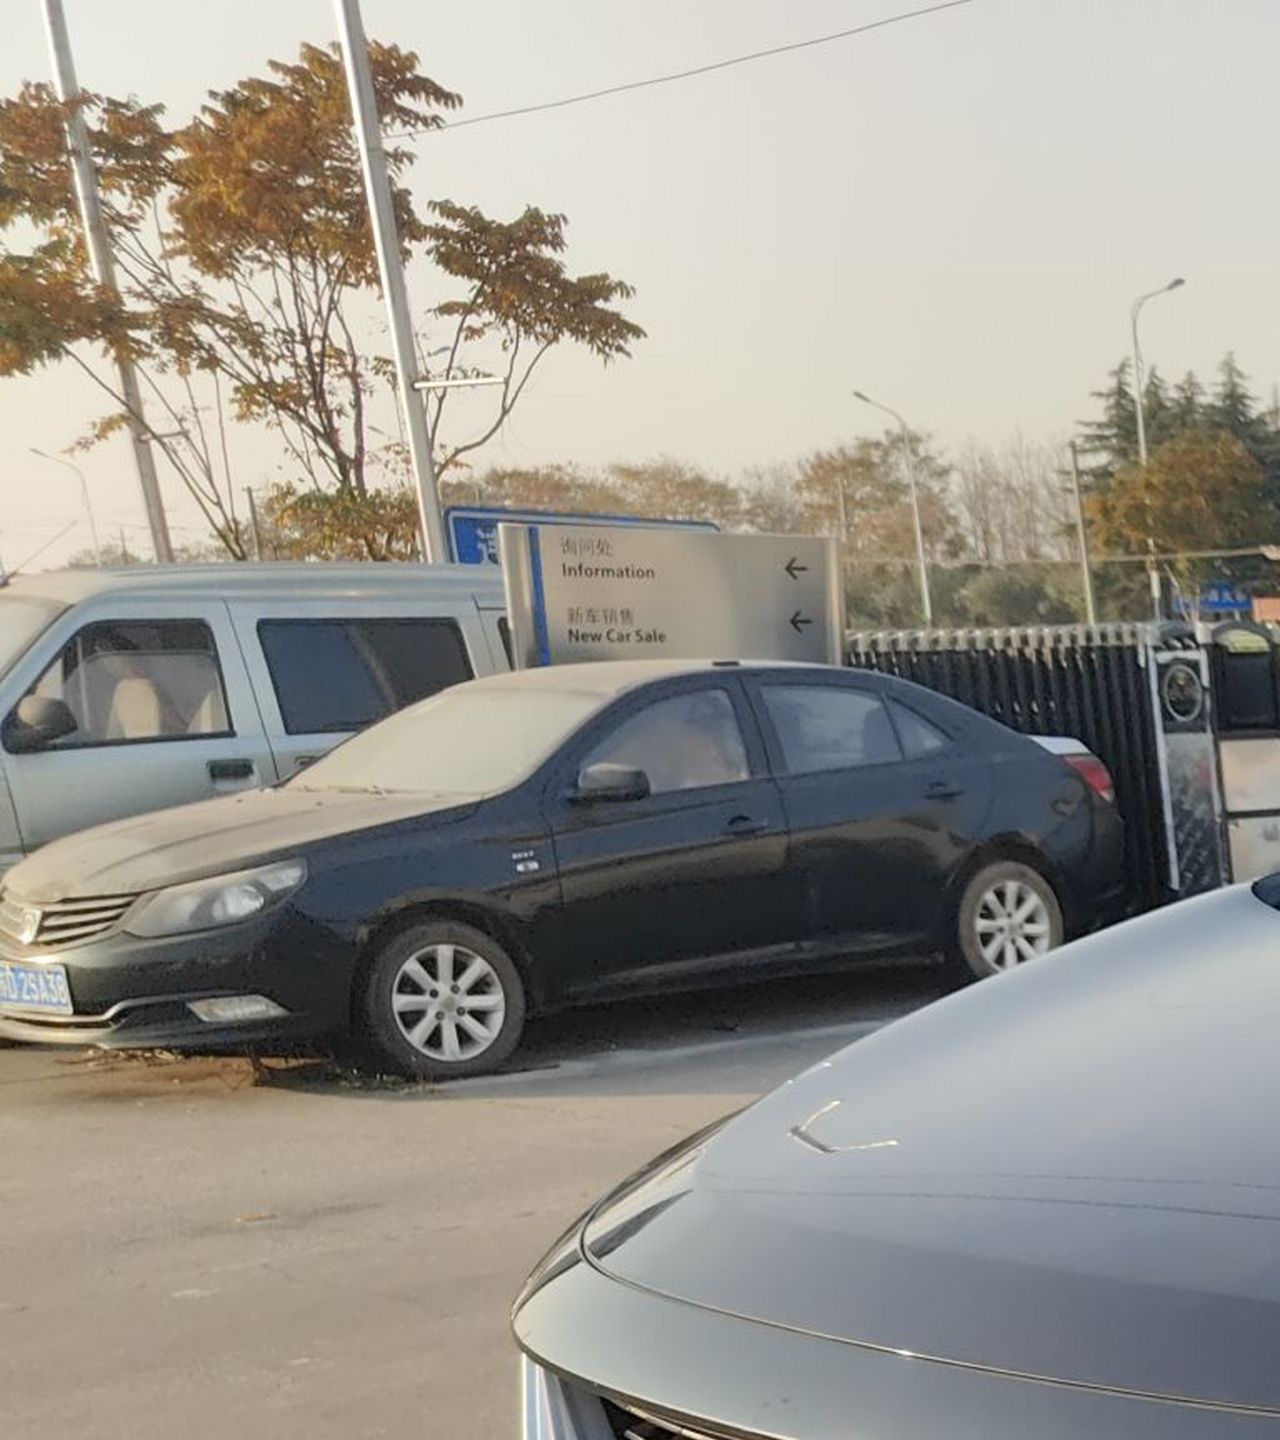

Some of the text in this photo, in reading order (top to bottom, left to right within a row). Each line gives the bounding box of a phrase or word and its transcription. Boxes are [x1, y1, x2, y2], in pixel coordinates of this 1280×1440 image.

[560, 535, 614, 557] 询问处
[561, 562, 656, 579] Information
[567, 606, 635, 625] 新车销售
[567, 628, 667, 643] New Car Sale
